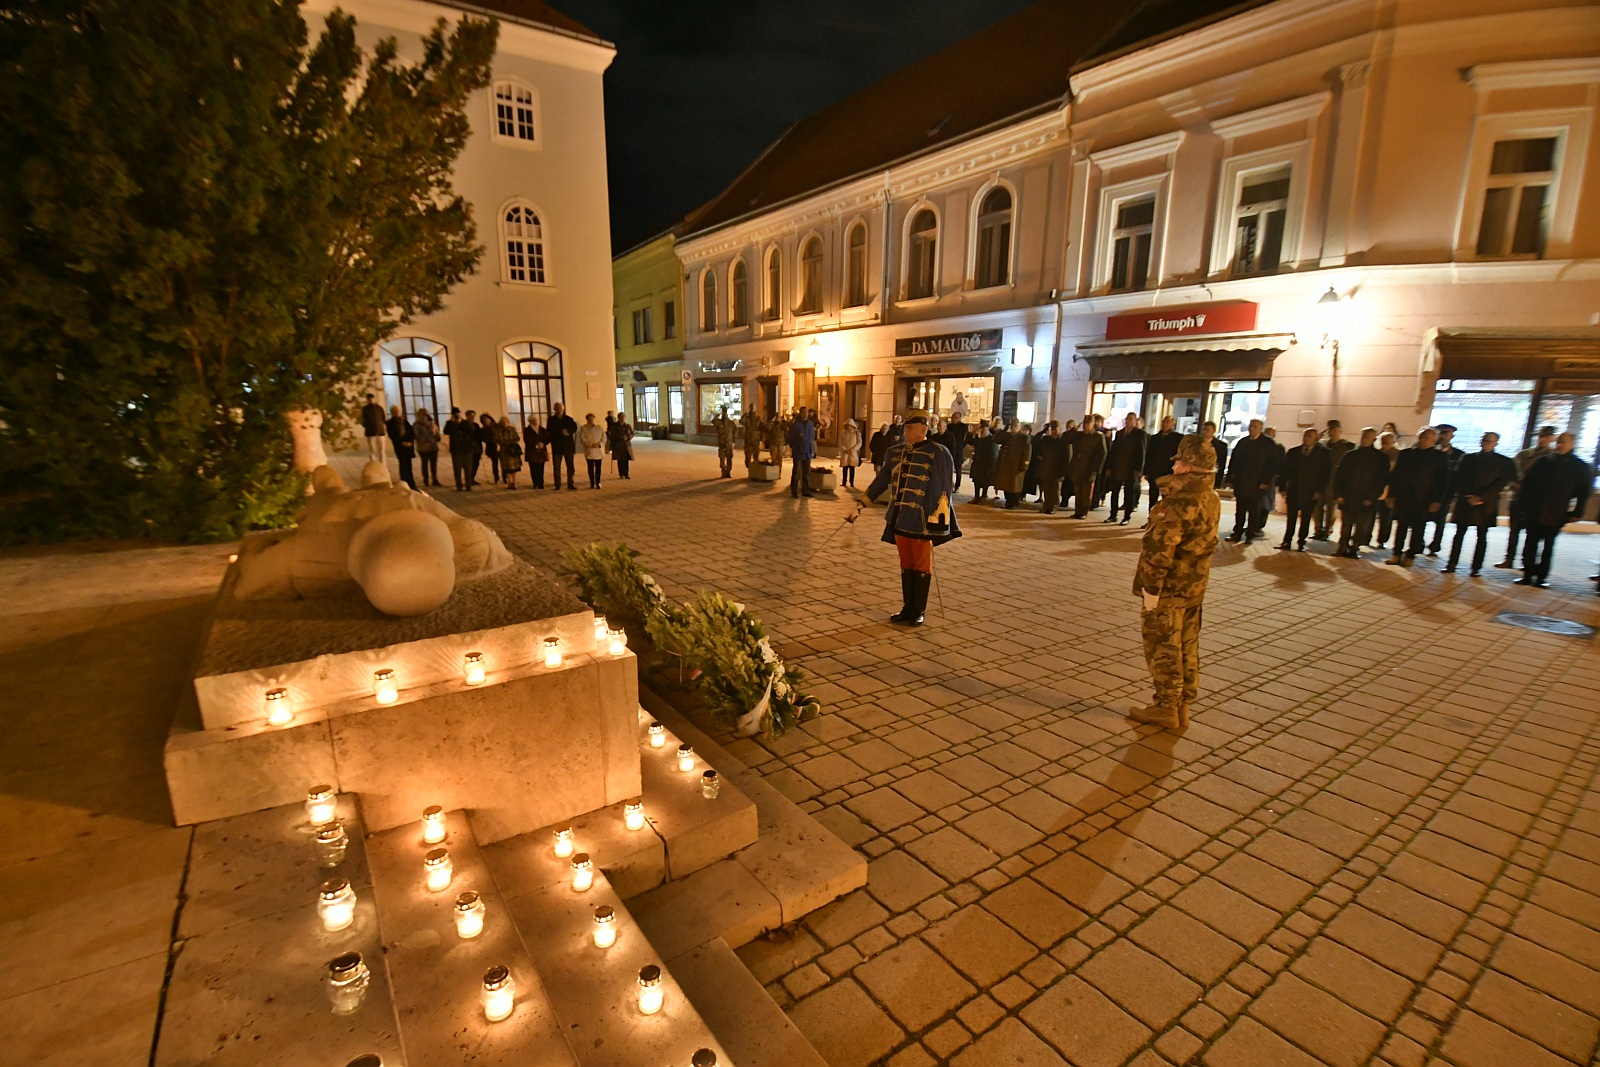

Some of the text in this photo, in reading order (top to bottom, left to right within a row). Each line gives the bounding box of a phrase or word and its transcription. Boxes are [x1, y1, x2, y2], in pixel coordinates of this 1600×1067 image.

[1148, 317, 1194, 331] Triumph
[912, 334, 980, 354] DA MAURO
